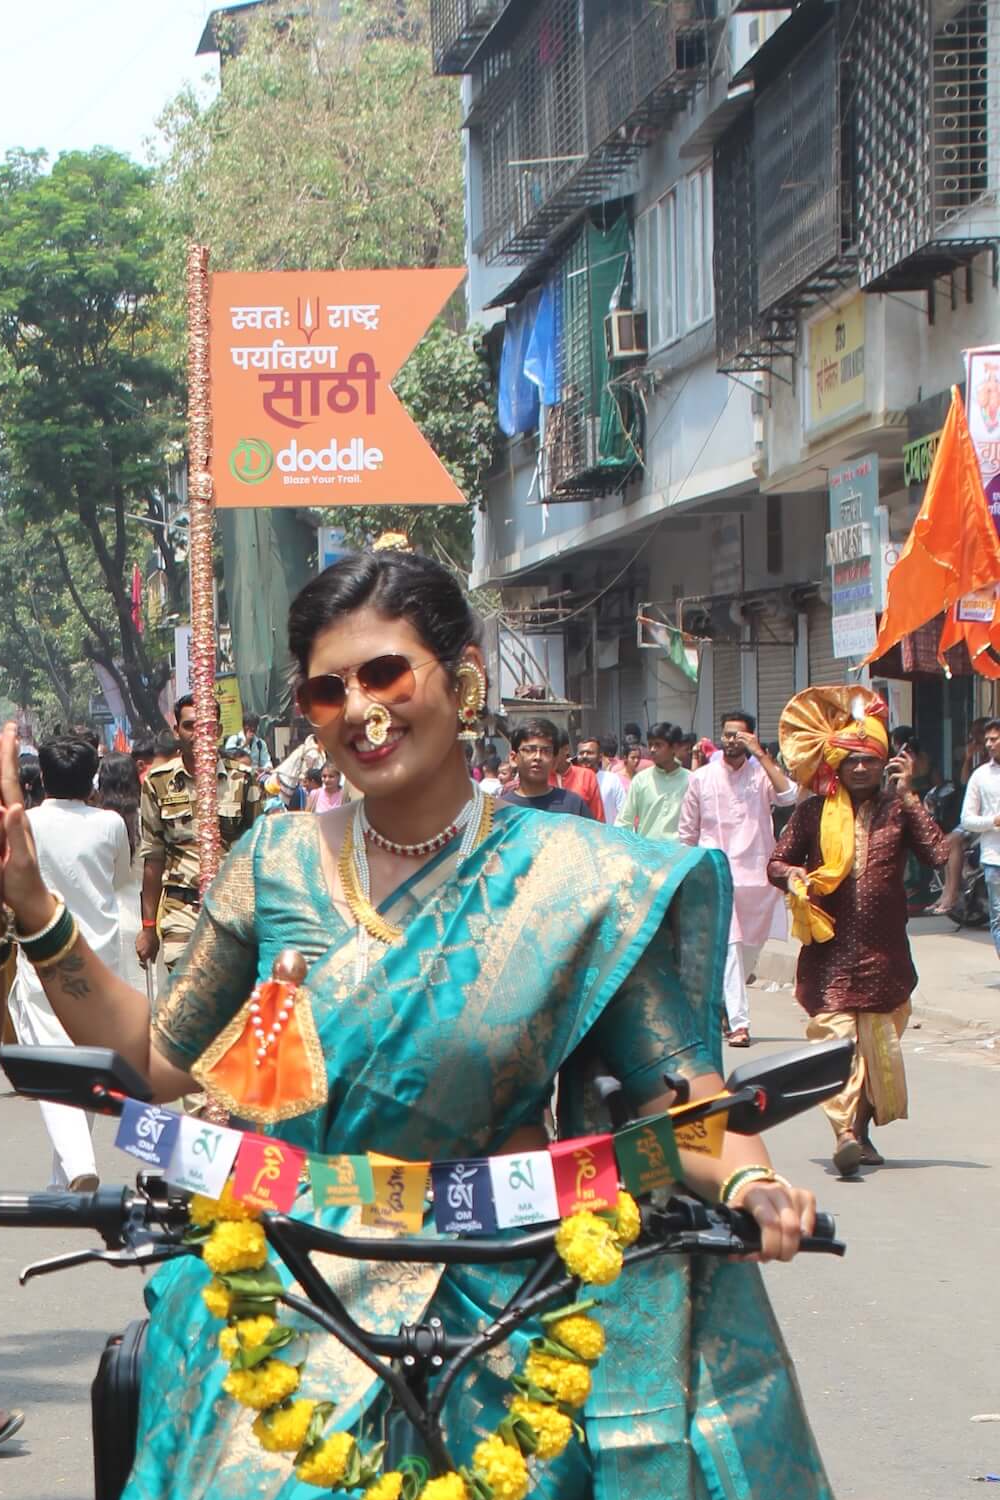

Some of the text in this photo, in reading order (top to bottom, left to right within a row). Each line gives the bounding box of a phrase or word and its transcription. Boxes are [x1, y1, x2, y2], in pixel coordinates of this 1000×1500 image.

[229, 304, 380, 330] स्वतः राष्ट्र
[229, 340, 339, 370] पर्यावरण
[257, 352, 380, 429] साठी
[276, 437, 383, 472] doddle
[283, 475, 310, 485] Blaze
[311, 475, 336, 485] Your
[455, 1211, 473, 1220] OM
